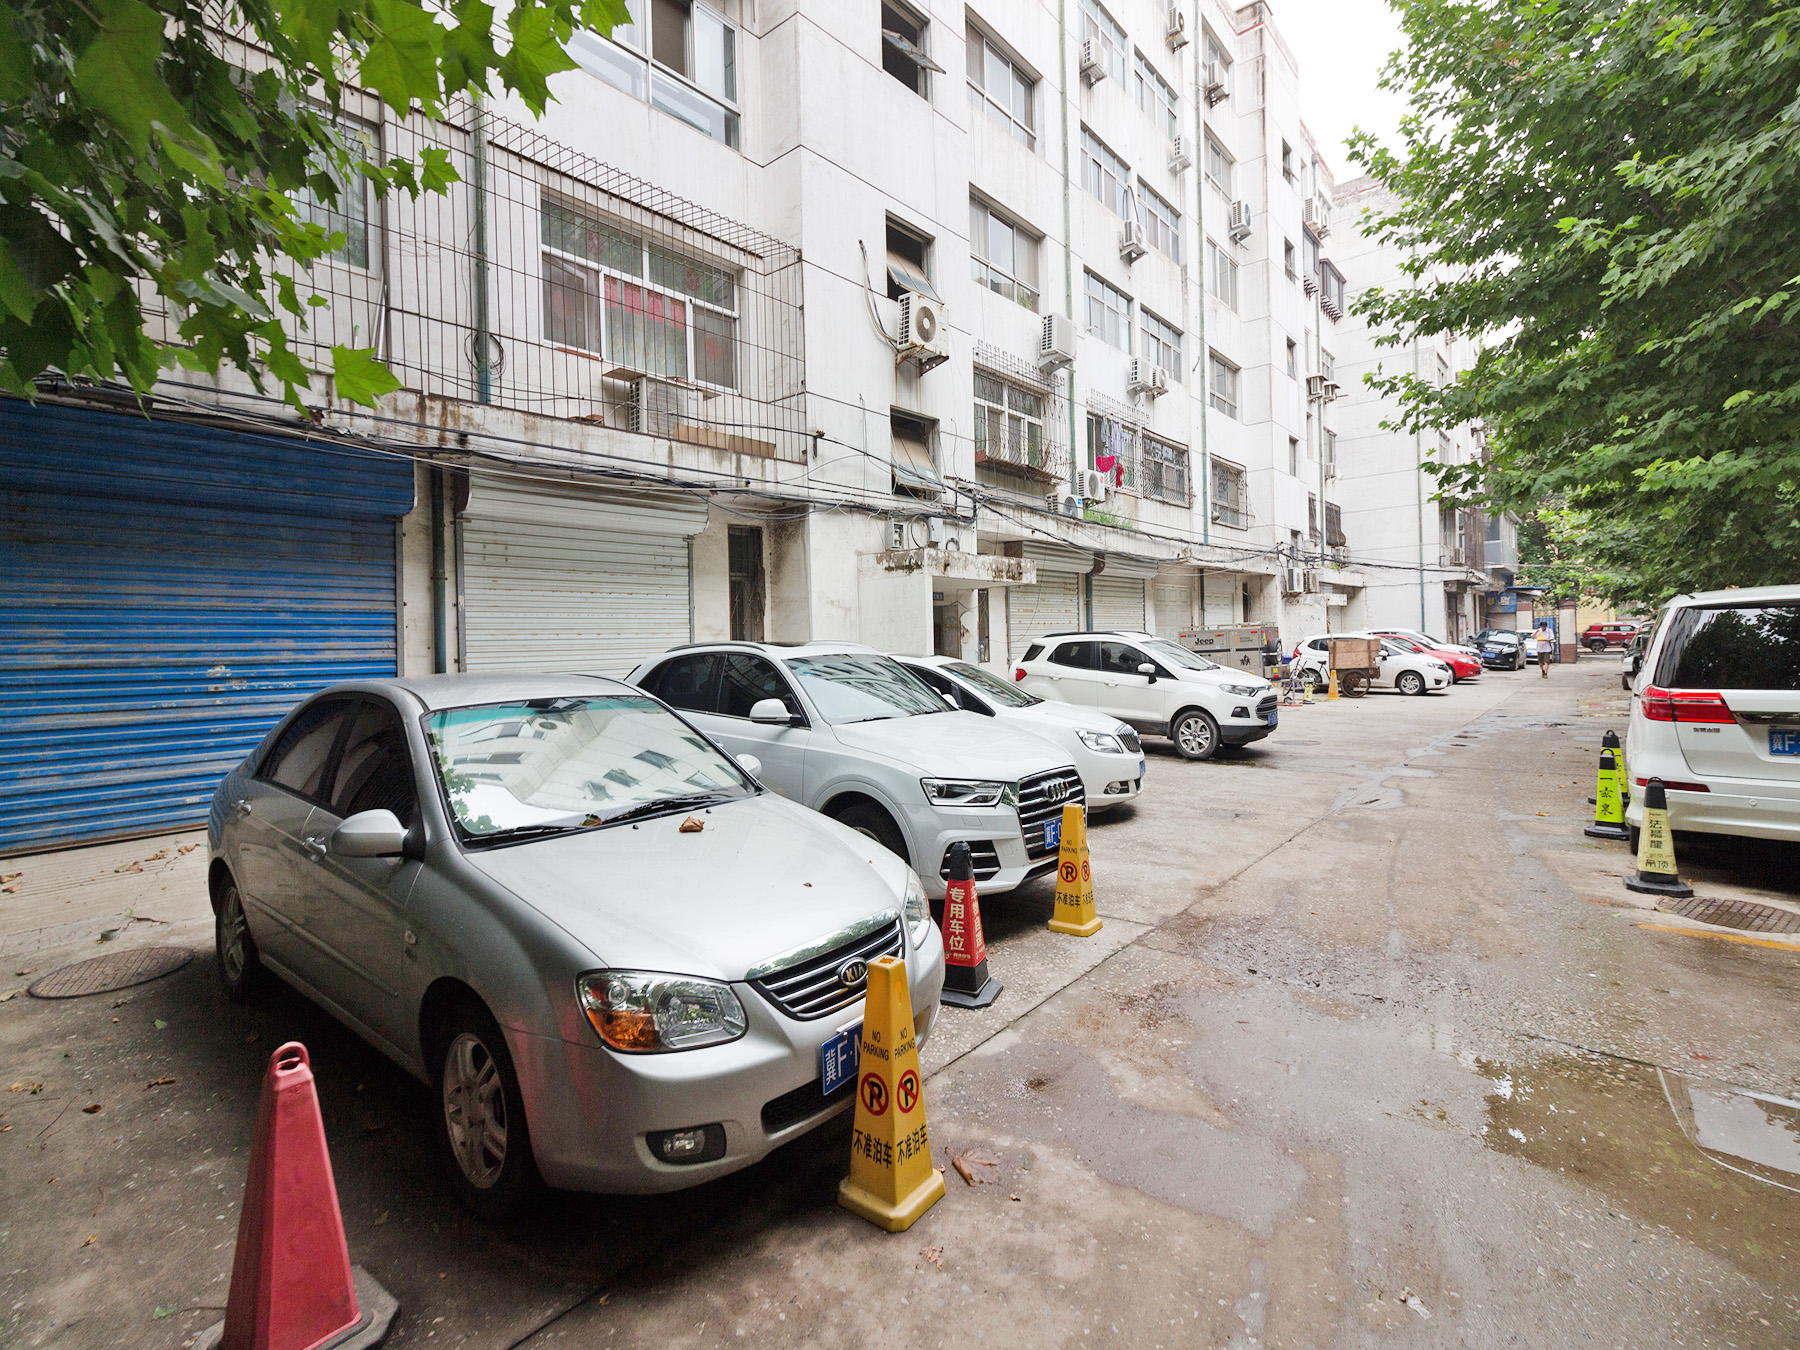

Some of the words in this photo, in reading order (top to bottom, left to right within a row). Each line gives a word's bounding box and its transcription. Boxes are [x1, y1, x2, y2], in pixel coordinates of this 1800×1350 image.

[1061, 846, 1078, 854] PARKING
[1056, 891, 1080, 908] 不准泊车
[949, 887, 965, 951] 专用车位
[846, 963, 864, 981] KIA
[872, 1029, 880, 1043] NO
[900, 1027, 907, 1040] NO
[863, 1041, 889, 1061] PARKING
[894, 1038, 915, 1059] PARKING
[854, 1128, 892, 1169] 不准泊车
[897, 1123, 927, 1166] 不准泊车
